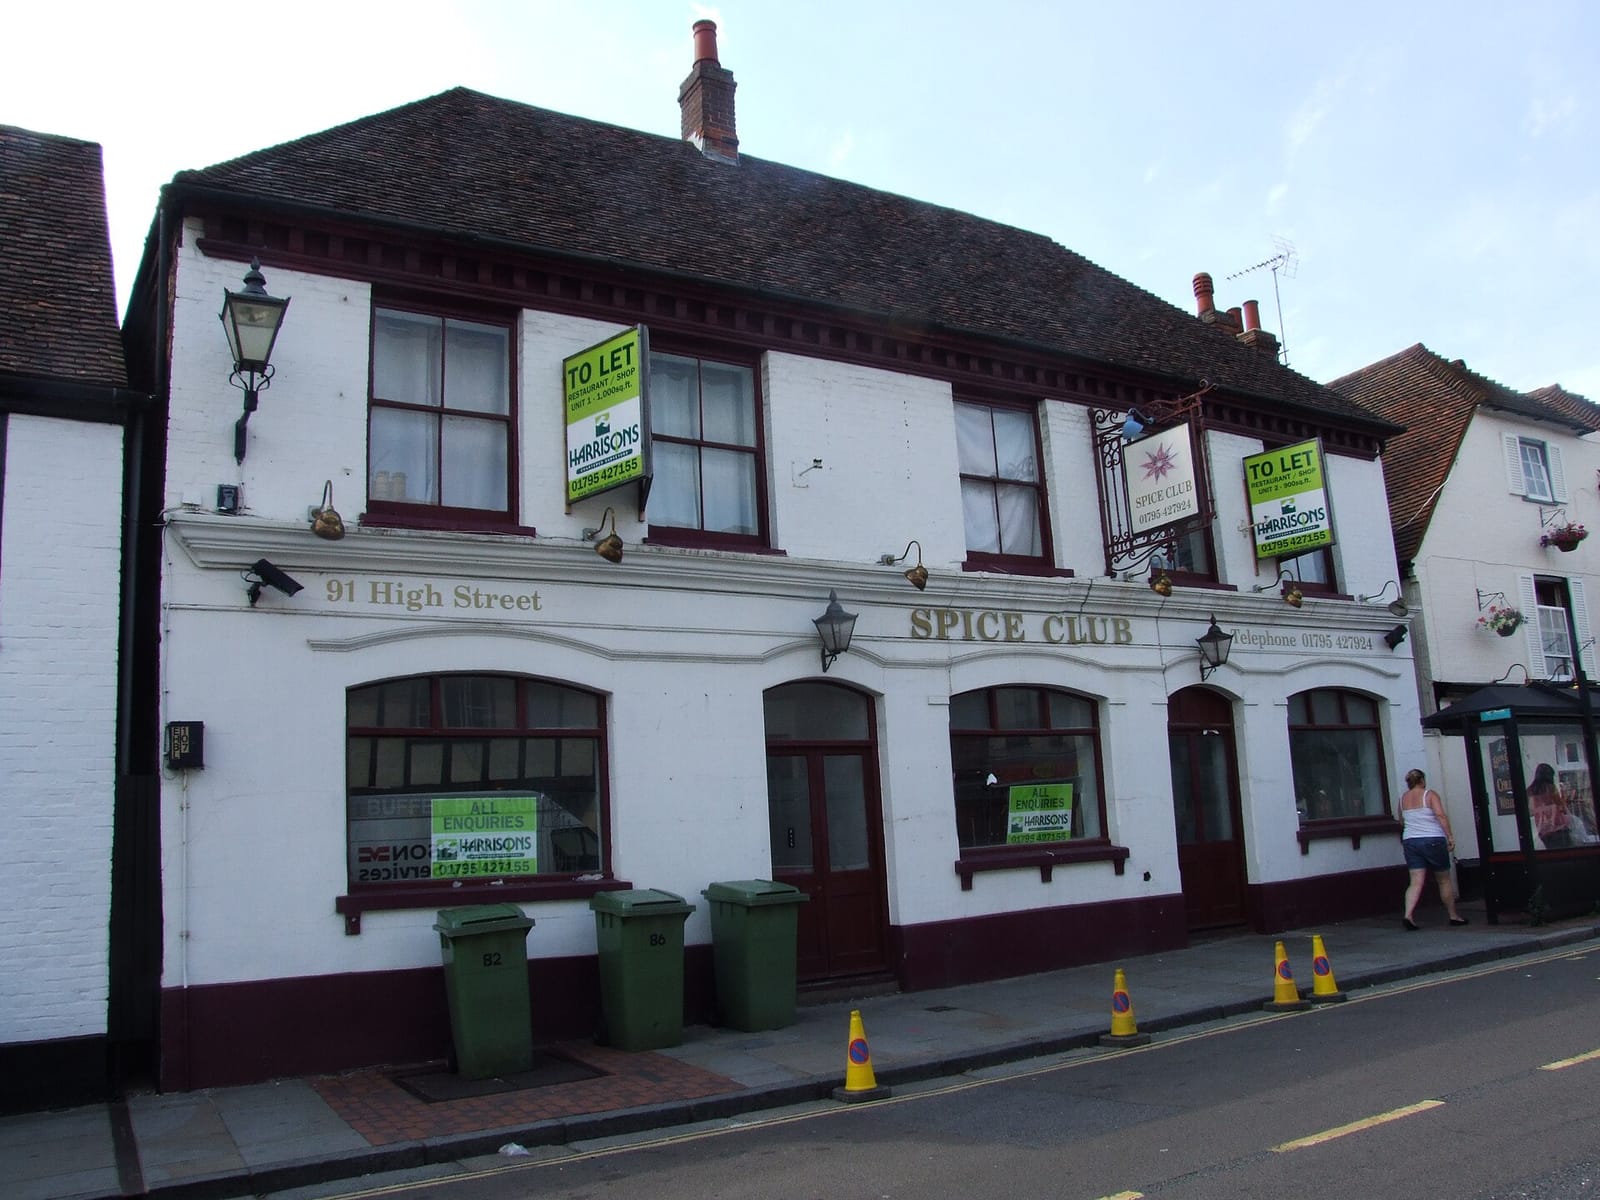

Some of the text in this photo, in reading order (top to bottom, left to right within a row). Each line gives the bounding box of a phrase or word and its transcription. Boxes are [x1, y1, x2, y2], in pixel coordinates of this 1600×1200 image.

[567, 342, 635, 390] TO LET
[568, 378, 609, 402] RESTAURANT
[616, 367, 636, 382] SHOP
[571, 398, 586, 412] UNIT
[569, 424, 639, 468] HARRISONS
[571, 471, 600, 492] 01795
[601, 457, 638, 481] 427155
[1249, 450, 1313, 480] TO LET
[1250, 473, 1291, 489] RESTAURANT
[1298, 467, 1317, 477] SHOP
[1135, 479, 1193, 509] SPICE CLUB
[1139, 499, 1192, 525] 01795 427924
[1257, 507, 1325, 536] HARRISONS
[1261, 541, 1289, 553] 01795
[1290, 531, 1327, 546] 427155
[326, 579, 543, 612] 91 High Street
[911, 607, 1134, 645] SPICE CLUB
[1230, 628, 1373, 651] Telephone 01795 427924
[1032, 787, 1049, 798] ALL
[471, 801, 498, 815] ALL
[1016, 798, 1064, 810] ENQUIRIES
[443, 815, 525, 831] ENQUIRIES
[1024, 814, 1068, 826] HARRISONS
[459, 836, 532, 853] HARRISONS
[438, 860, 530, 876] 01795 427155
[650, 934, 666, 946] 86
[483, 953, 503, 968] 82
